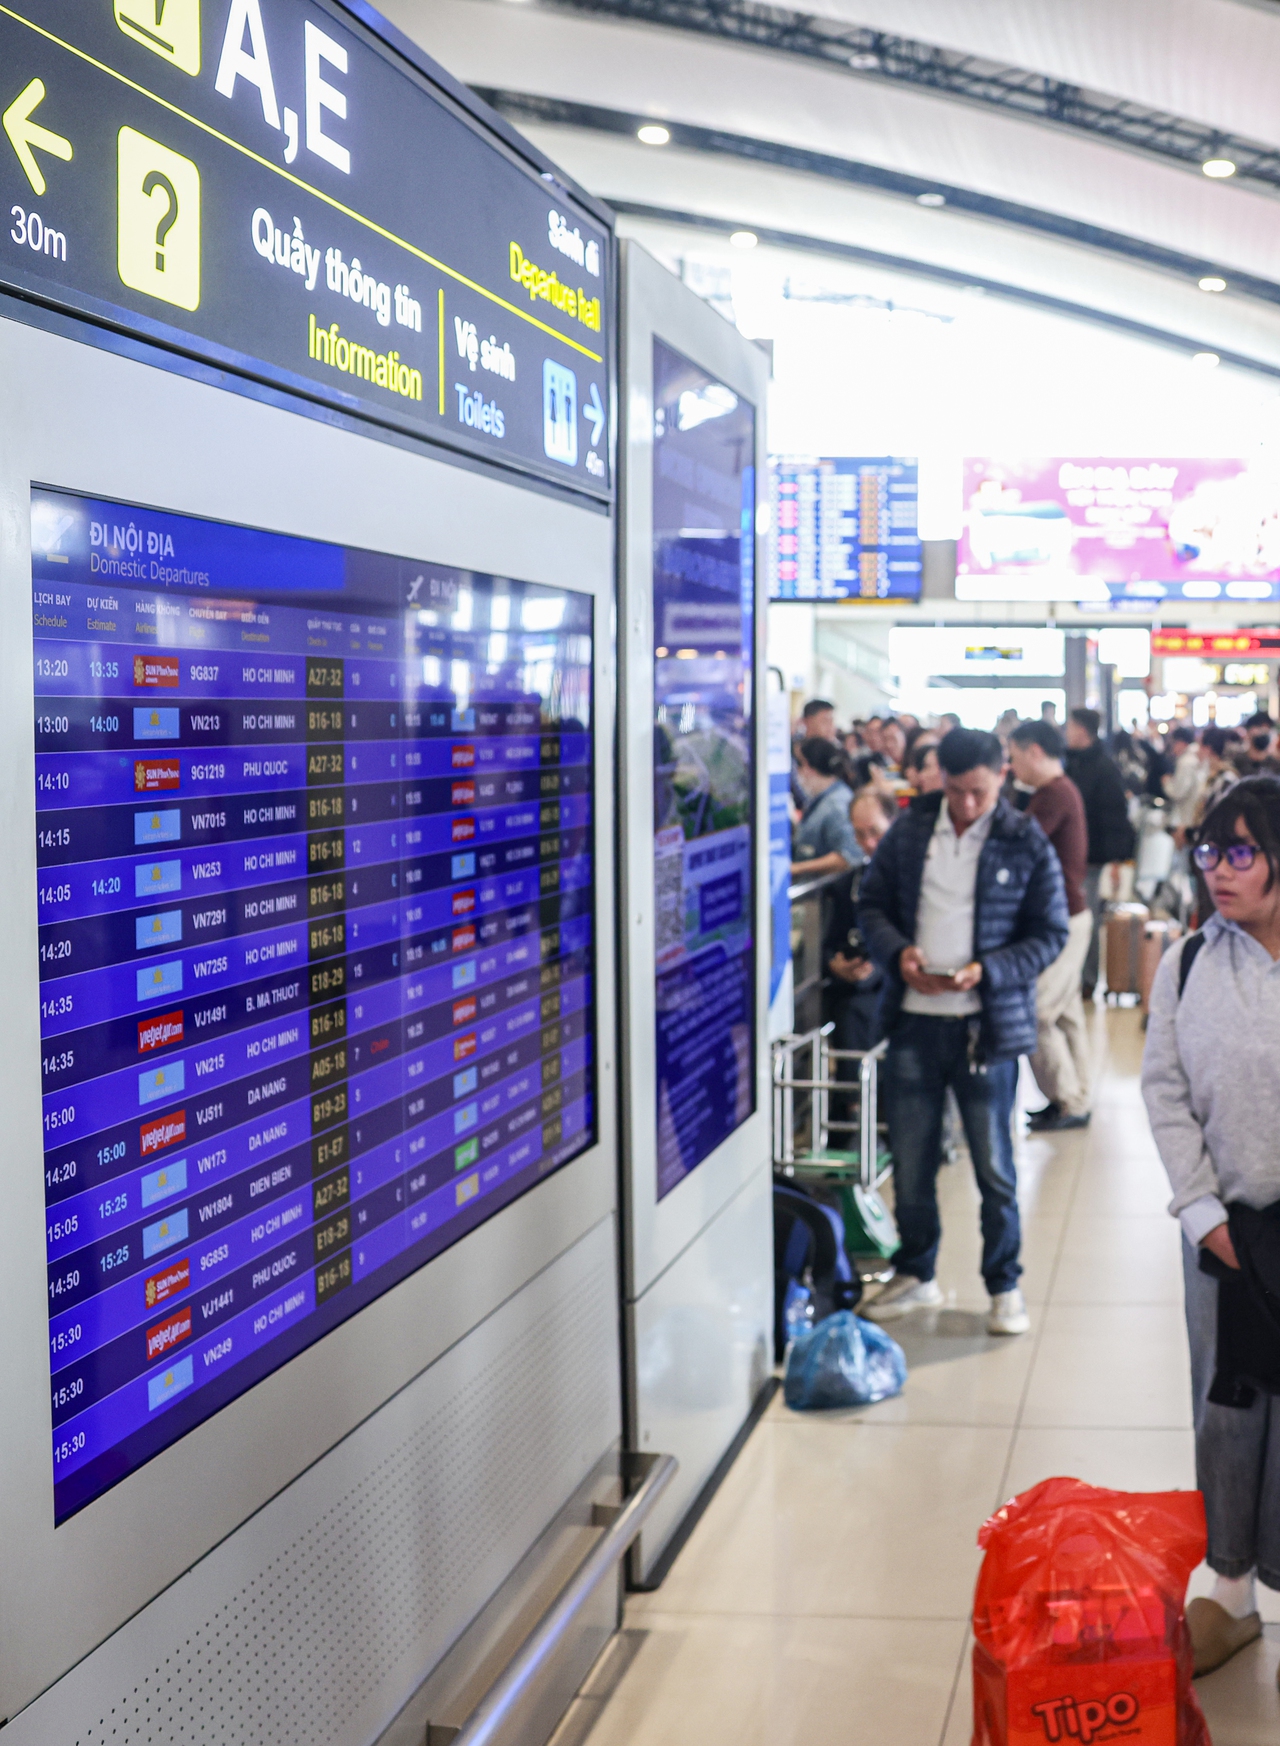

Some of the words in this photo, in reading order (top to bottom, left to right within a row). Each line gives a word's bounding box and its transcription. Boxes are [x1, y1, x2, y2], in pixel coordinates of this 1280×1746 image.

[214, 0, 351, 174] A,E
[10, 205, 66, 262] 30m
[251, 207, 320, 291] Quầy
[326, 248, 390, 326] thông
[394, 282, 422, 332] tin
[510, 241, 577, 318] Departure
[578, 287, 600, 332] hall
[309, 314, 422, 400] Information
[454, 316, 478, 372] Vệ
[481, 335, 516, 382] sinh
[454, 382, 505, 438] Toilets
[90, 522, 107, 547] ĐI
[114, 522, 142, 557] NỘI
[147, 532, 174, 560] ĐỊA
[91, 552, 146, 578] Domestic
[150, 561, 209, 586] Departures
[34, 592, 53, 606] LỊCH
[56, 594, 71, 606] BAY
[34, 614, 67, 628] Schedule
[87, 618, 116, 631] Estimate
[37, 659, 68, 676] 13:20
[90, 661, 118, 680] 13:35
[191, 666, 218, 680] 9G837
[243, 668, 256, 682] HO
[258, 668, 272, 682] CHI
[274, 669, 294, 683] MINH
[309, 668, 341, 686] A27-32
[38, 716, 68, 733] 13:00
[90, 716, 118, 732] 14:00
[191, 716, 219, 730] VN213
[243, 715, 256, 729] HO
[258, 715, 272, 729] CHI
[274, 715, 295, 728] MINH
[309, 712, 341, 729] B16-18
[39, 773, 69, 790] 14:10
[191, 764, 225, 780] 9G1219
[244, 762, 261, 776] PHU
[263, 760, 288, 775] QUOC
[309, 755, 342, 773] A27-32
[39, 828, 70, 847] 14:15
[192, 812, 225, 830] VN7015
[244, 809, 257, 823] HO
[259, 808, 273, 822] CHI
[275, 805, 295, 820] MINH
[310, 797, 342, 817] B16-18
[40, 884, 70, 904] 14:05
[92, 877, 120, 896] 14:20
[193, 862, 221, 879] VN253
[245, 856, 257, 871] HO
[259, 853, 274, 868] CHI
[276, 850, 296, 865] MINH
[310, 840, 342, 861] B16-18
[41, 940, 71, 961] 14:20
[193, 909, 225, 929] VN7291
[245, 902, 258, 918] HO
[260, 899, 274, 914] CHI
[276, 895, 296, 911] MINH
[311, 883, 343, 905] B16-18
[42, 995, 72, 1018] 14:35
[194, 957, 227, 978] VN7255
[246, 949, 258, 964] HO
[260, 944, 275, 960] CHI
[277, 939, 297, 956] MINH
[311, 925, 343, 948] B16-18
[43, 1051, 73, 1074] 14:35
[195, 1005, 226, 1027] VJ1491
[246, 997, 255, 1011] B.
[257, 992, 270, 1008] MA
[272, 983, 299, 1003] THUOT
[312, 968, 343, 992] E18-29
[45, 1106, 74, 1130] 15:00
[196, 1054, 224, 1076] VN215
[247, 1042, 260, 1058] HO
[262, 1036, 276, 1052] CHI
[278, 1028, 298, 1046] MINH
[312, 1010, 344, 1036] B16-18
[47, 1161, 76, 1186] 14:20
[97, 1142, 125, 1165] 15:00
[196, 1103, 222, 1125] VJ511
[248, 1088, 260, 1105] DA
[262, 1078, 286, 1098] NANG
[313, 1051, 345, 1079] A05-18
[48, 1215, 78, 1242] 15:05
[99, 1193, 127, 1218] 15:25
[198, 1150, 226, 1173] VN173
[249, 1134, 261, 1151] DA
[263, 1122, 287, 1144] NANG
[314, 1094, 345, 1122] B19-23
[50, 1270, 79, 1297] 14:50
[101, 1245, 129, 1271] 15:25
[250, 1176, 270, 1197] DIEN
[272, 1166, 291, 1186] BIEN
[318, 1137, 343, 1163] E1-E7
[51, 1324, 81, 1353] 15:30
[201, 1244, 228, 1270] 9G853
[252, 1225, 264, 1242] HO
[266, 1216, 280, 1234] CHI
[282, 1205, 302, 1225] MINH
[315, 1177, 347, 1208] A27-32
[53, 1378, 83, 1408] 15:30
[202, 1289, 233, 1318] VJ1441
[253, 1267, 270, 1288] PHU
[272, 1252, 296, 1276] QUOC
[317, 1219, 348, 1250] E18-29
[55, 1432, 85, 1462] 15:30
[204, 1338, 232, 1366] VN249
[254, 1315, 267, 1334] HO
[269, 1305, 283, 1323] CHI
[284, 1291, 304, 1314] MINH
[1032, 1692, 1138, 1742] Tipo
